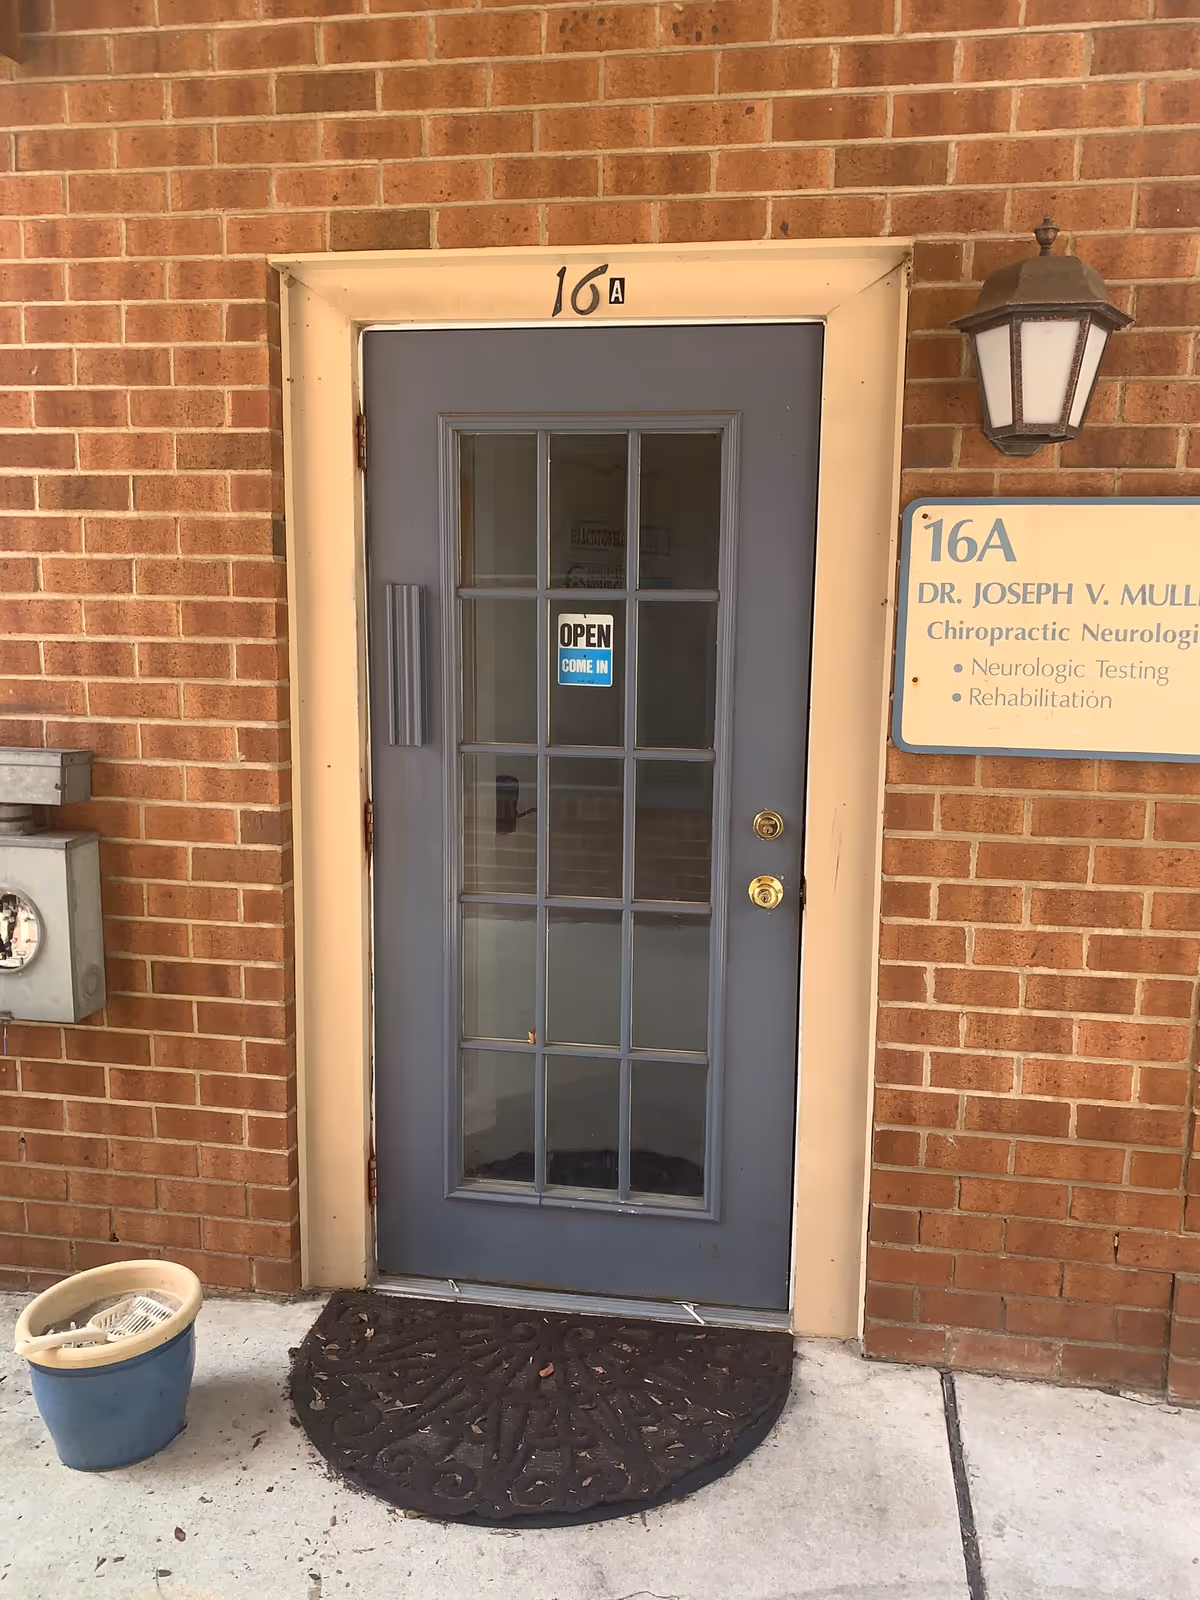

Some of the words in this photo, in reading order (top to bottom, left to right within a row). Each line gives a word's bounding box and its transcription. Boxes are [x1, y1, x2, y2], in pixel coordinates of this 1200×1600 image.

[552, 264, 608, 317] 16
[610, 279, 624, 303] A
[923, 518, 1017, 562] 16A
[918, 582, 962, 604] DR.
[972, 582, 1074, 608] JOSEPH
[1086, 584, 1109, 606] V.
[1120, 583, 1200, 606] MULL
[560, 623, 611, 648] OPEN
[927, 620, 1070, 646] Chiropractic
[1082, 623, 1199, 650] Neurologi
[562, 659, 593, 673] COME
[596, 660, 608, 674] IN
[971, 657, 1086, 684] Neurologic
[1096, 660, 1170, 686] Testing
[969, 688, 1112, 708] Rehabilitation
